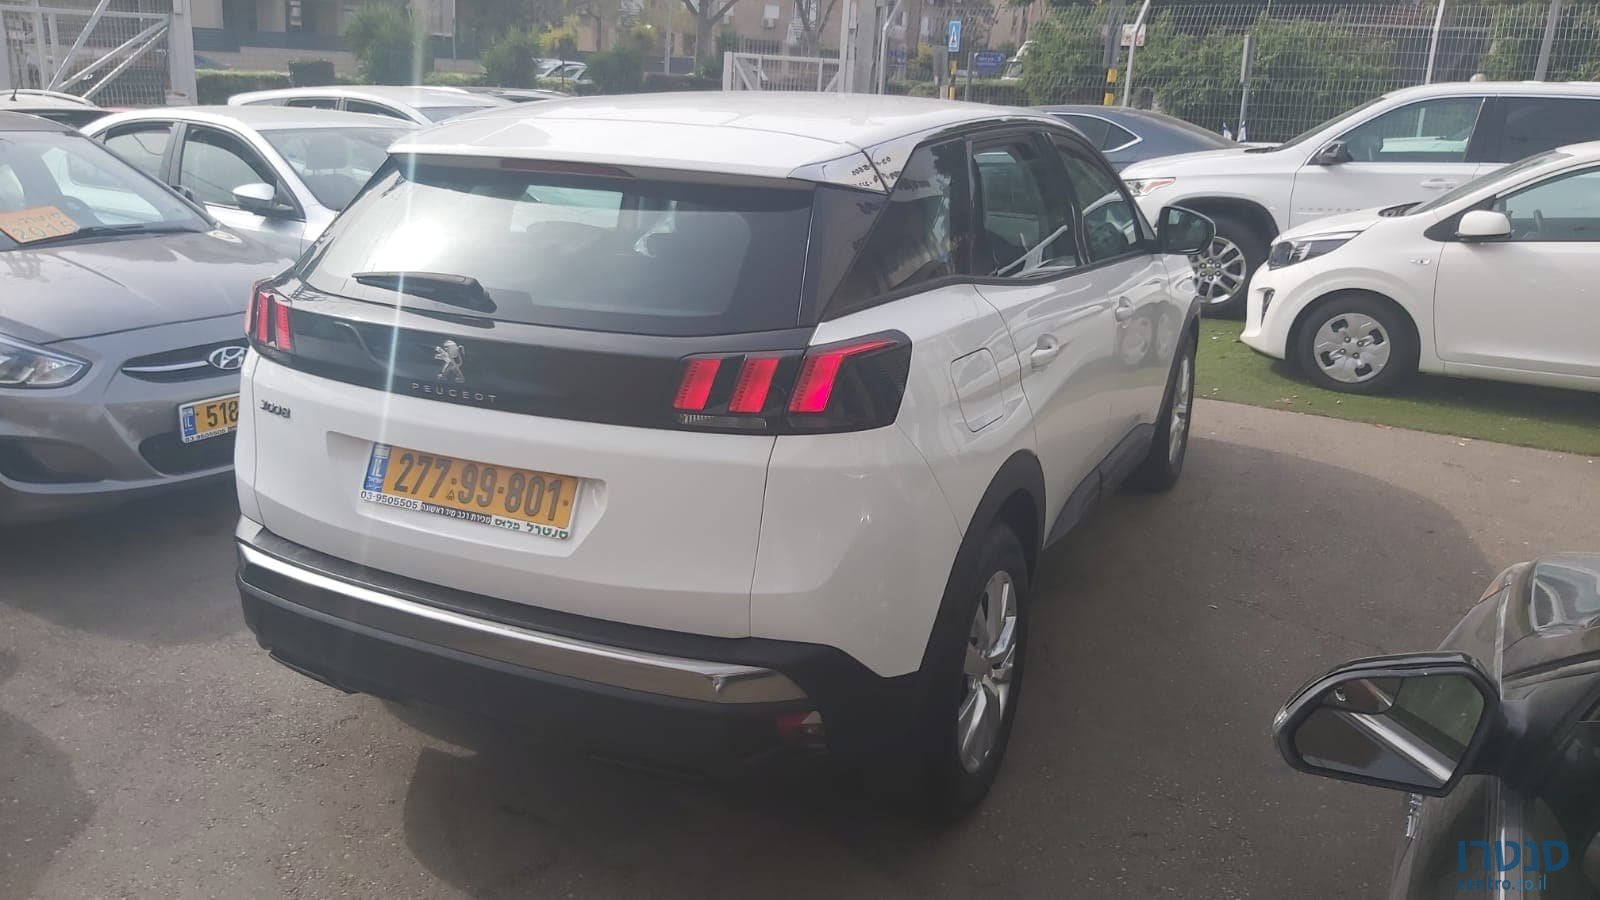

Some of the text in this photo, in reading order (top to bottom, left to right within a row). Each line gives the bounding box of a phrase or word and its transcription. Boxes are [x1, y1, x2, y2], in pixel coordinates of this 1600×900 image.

[412, 382, 496, 405] PEUGEOT
[360, 490, 418, 509] 03-9505505
[494, 518, 569, 540] סנטרל פלוס
